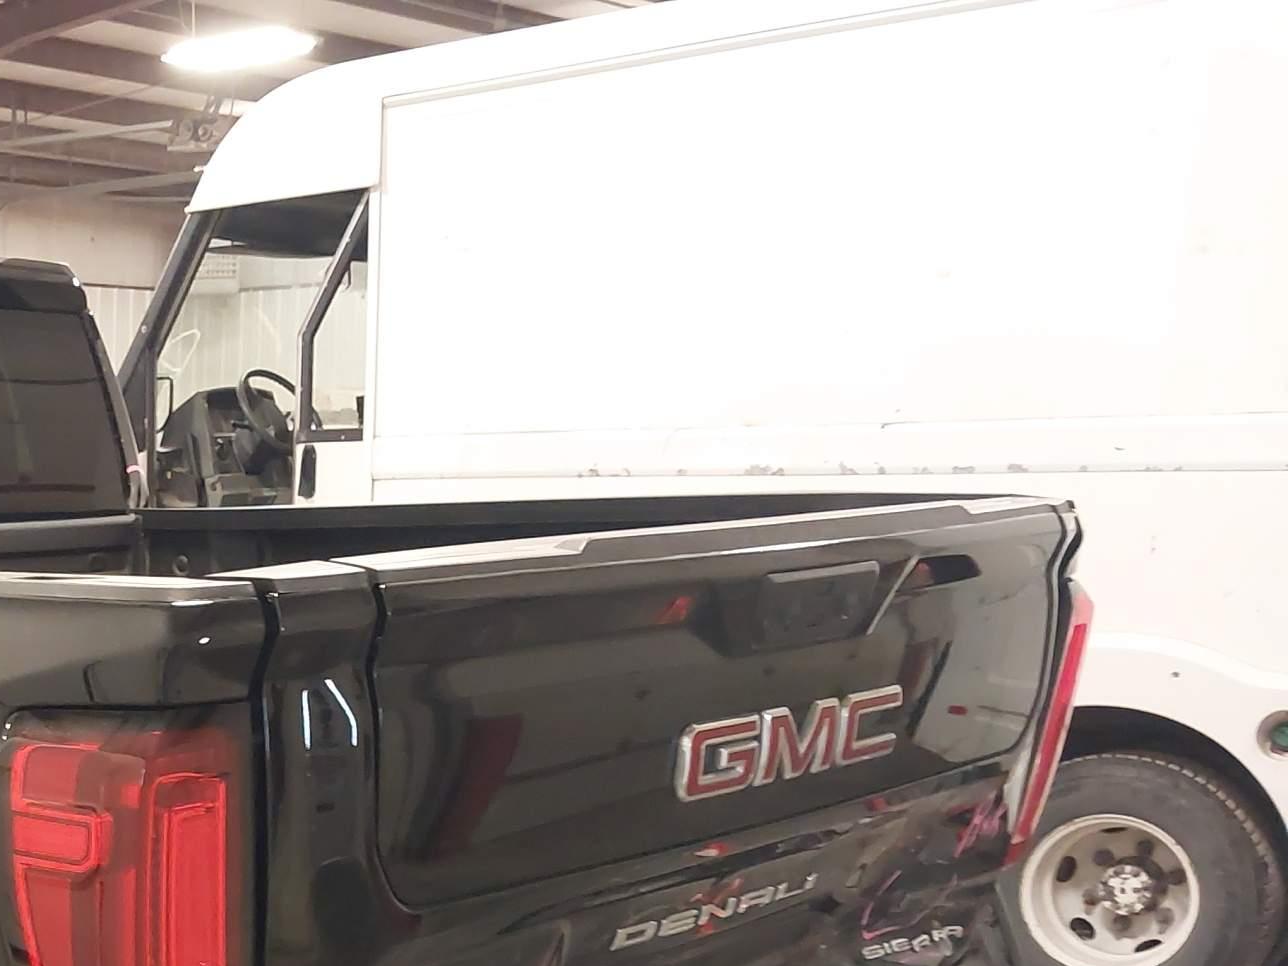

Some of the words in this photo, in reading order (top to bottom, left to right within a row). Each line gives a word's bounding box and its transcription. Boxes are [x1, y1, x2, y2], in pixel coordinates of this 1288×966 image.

[674, 684, 903, 802] GMC
[610, 872, 818, 951] DENALI
[861, 924, 964, 960] SIERRA
